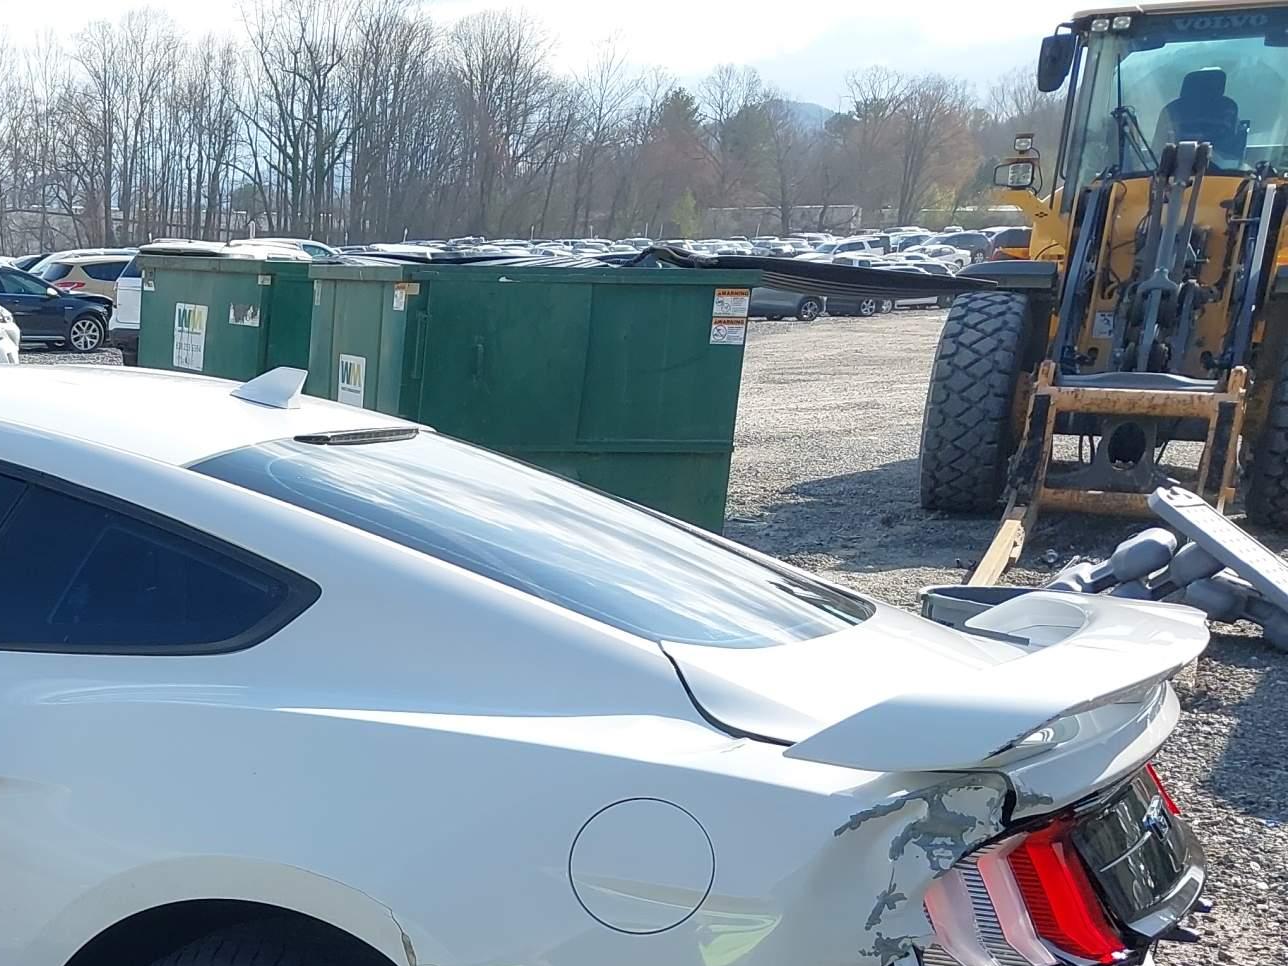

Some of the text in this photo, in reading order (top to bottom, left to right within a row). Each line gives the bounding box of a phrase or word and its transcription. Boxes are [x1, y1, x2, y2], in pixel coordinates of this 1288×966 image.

[1175, 14, 1268, 30] VOLVO
[178, 308, 203, 330] WM
[341, 360, 361, 386] WM
